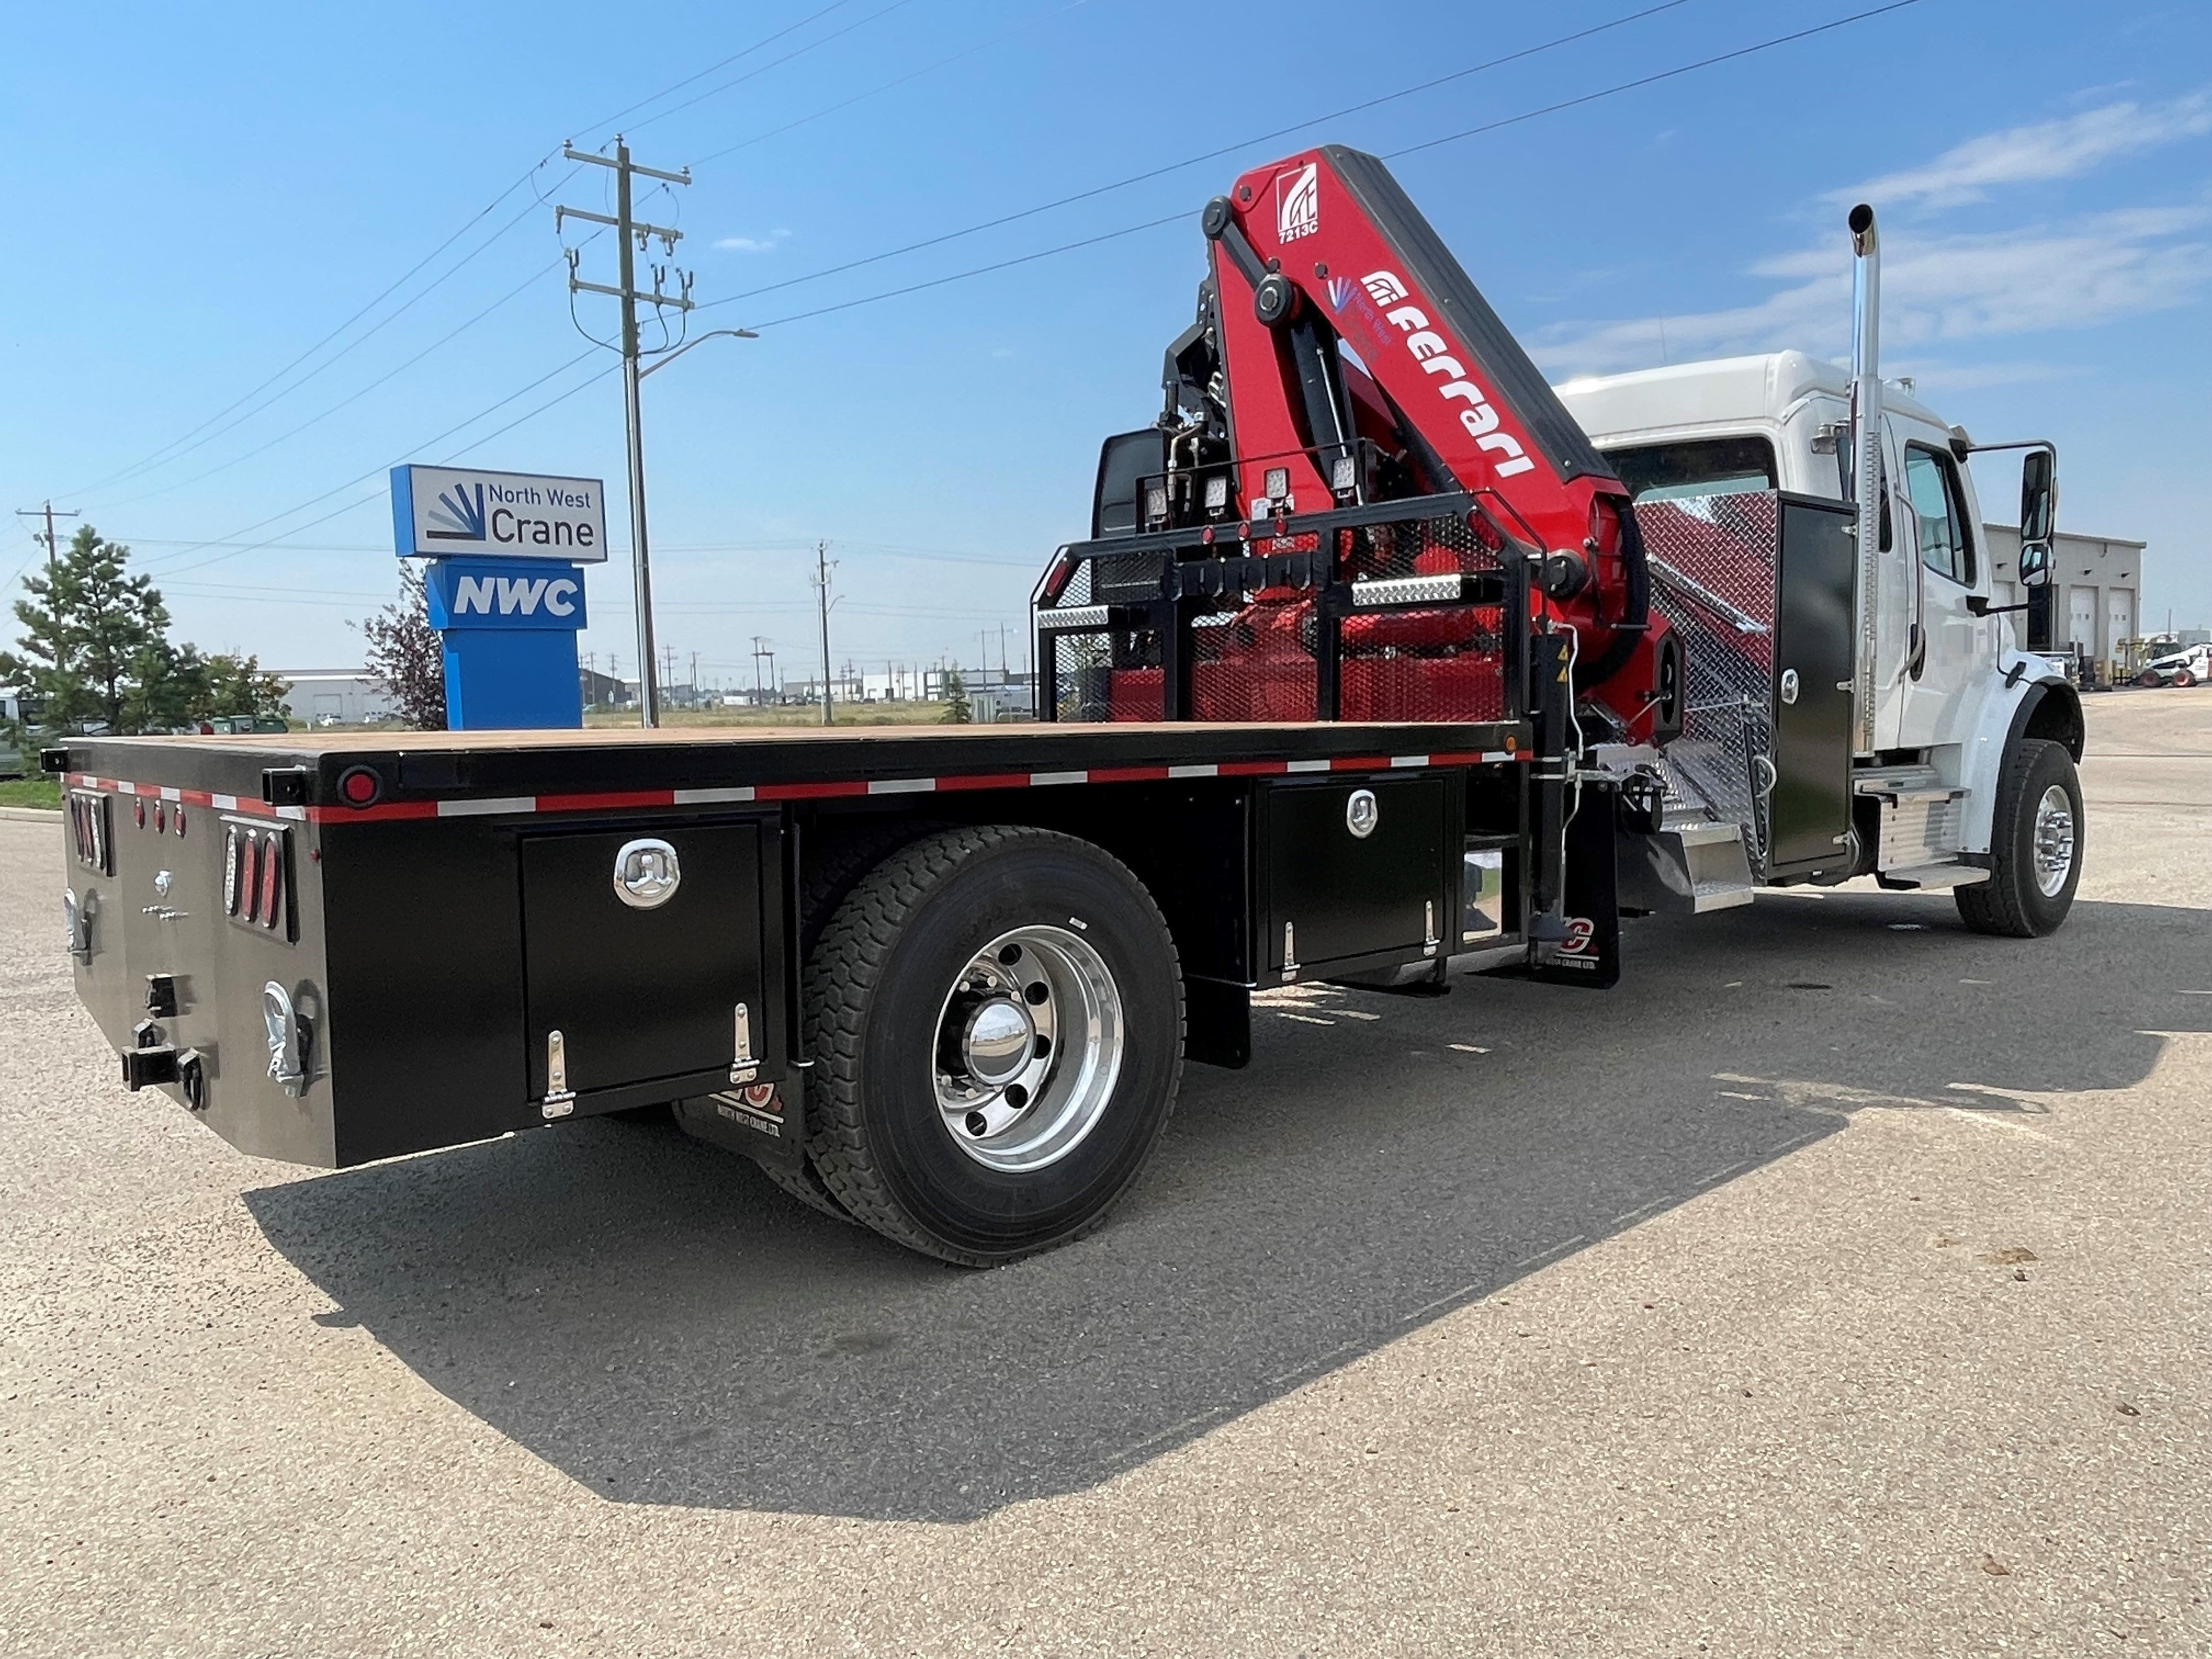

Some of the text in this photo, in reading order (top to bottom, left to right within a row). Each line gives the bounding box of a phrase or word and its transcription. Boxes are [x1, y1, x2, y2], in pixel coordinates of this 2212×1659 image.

[1278, 221, 1319, 245] 7213C
[488, 484, 591, 509] North West
[491, 508, 594, 547] Crane
[453, 575, 579, 617] NWC
